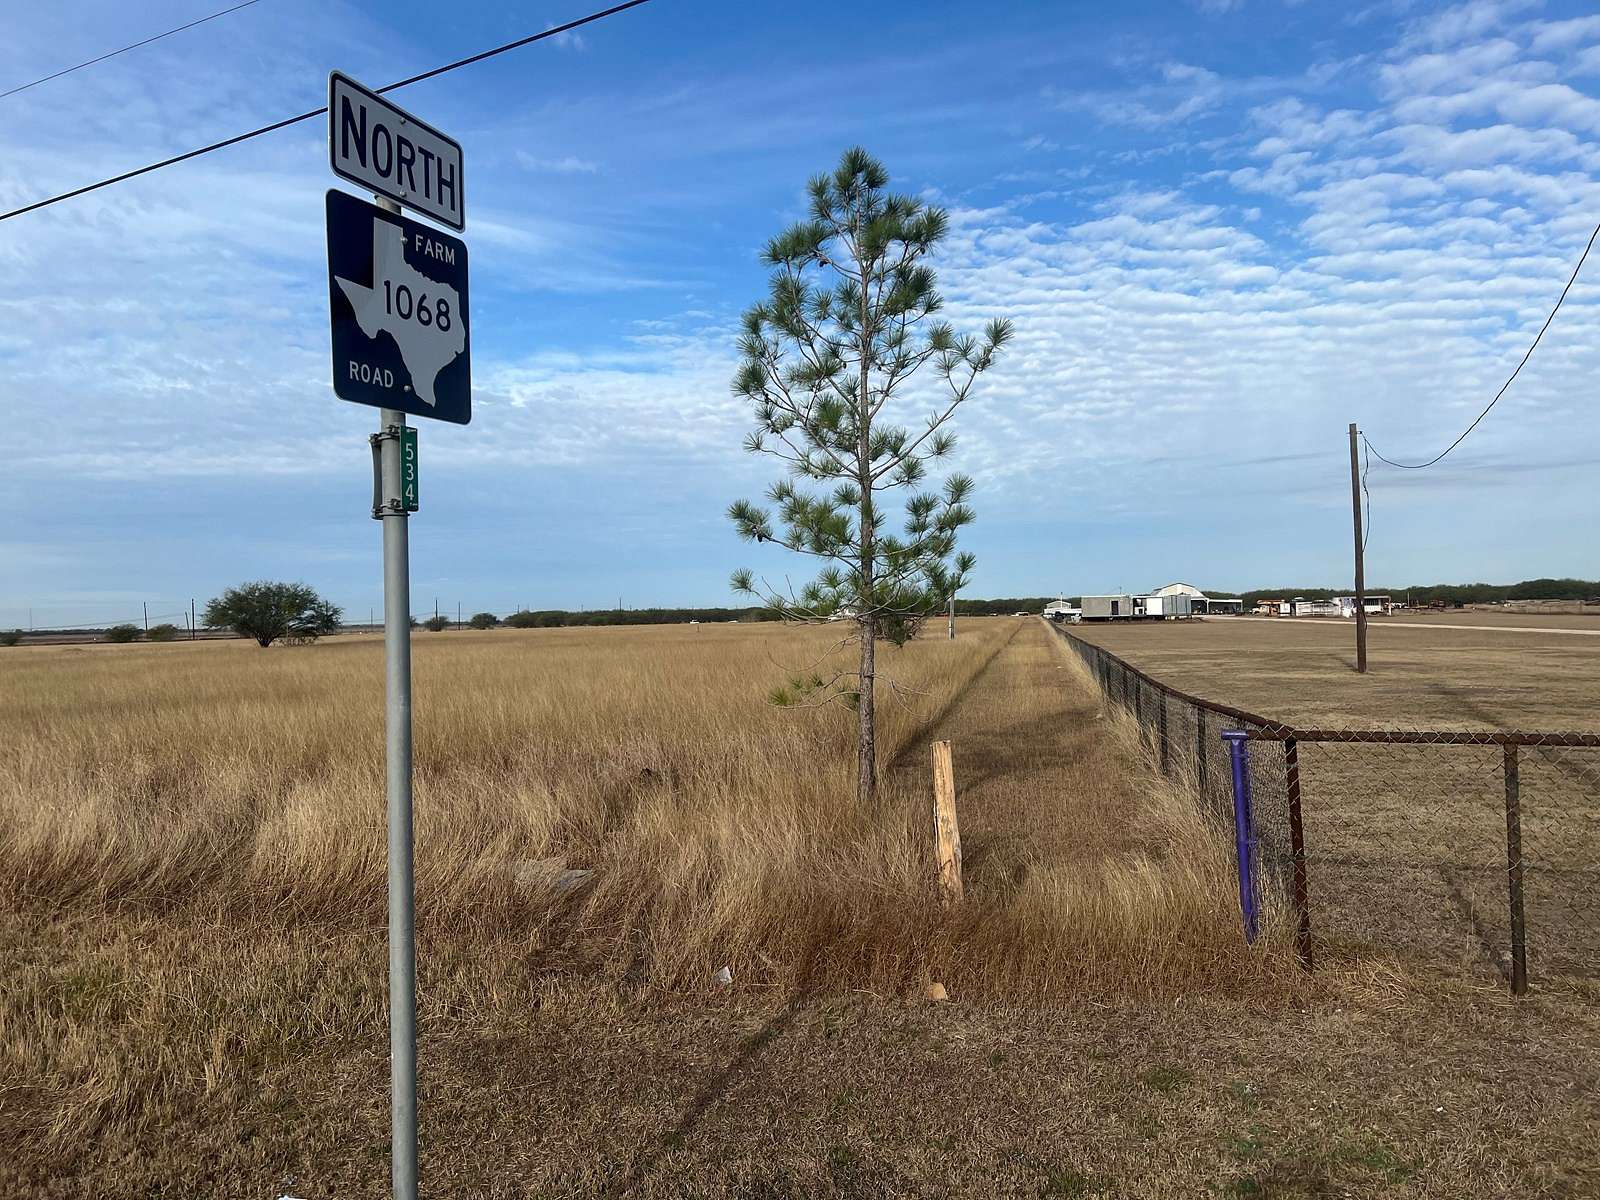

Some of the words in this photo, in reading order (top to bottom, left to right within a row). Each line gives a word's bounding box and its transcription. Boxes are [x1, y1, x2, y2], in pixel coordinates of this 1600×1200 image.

[342, 95, 455, 211] NORTH
[415, 234, 455, 265] FARM
[384, 280, 451, 332] 1068
[349, 361, 394, 388] ROAD
[405, 443, 415, 500] 534
